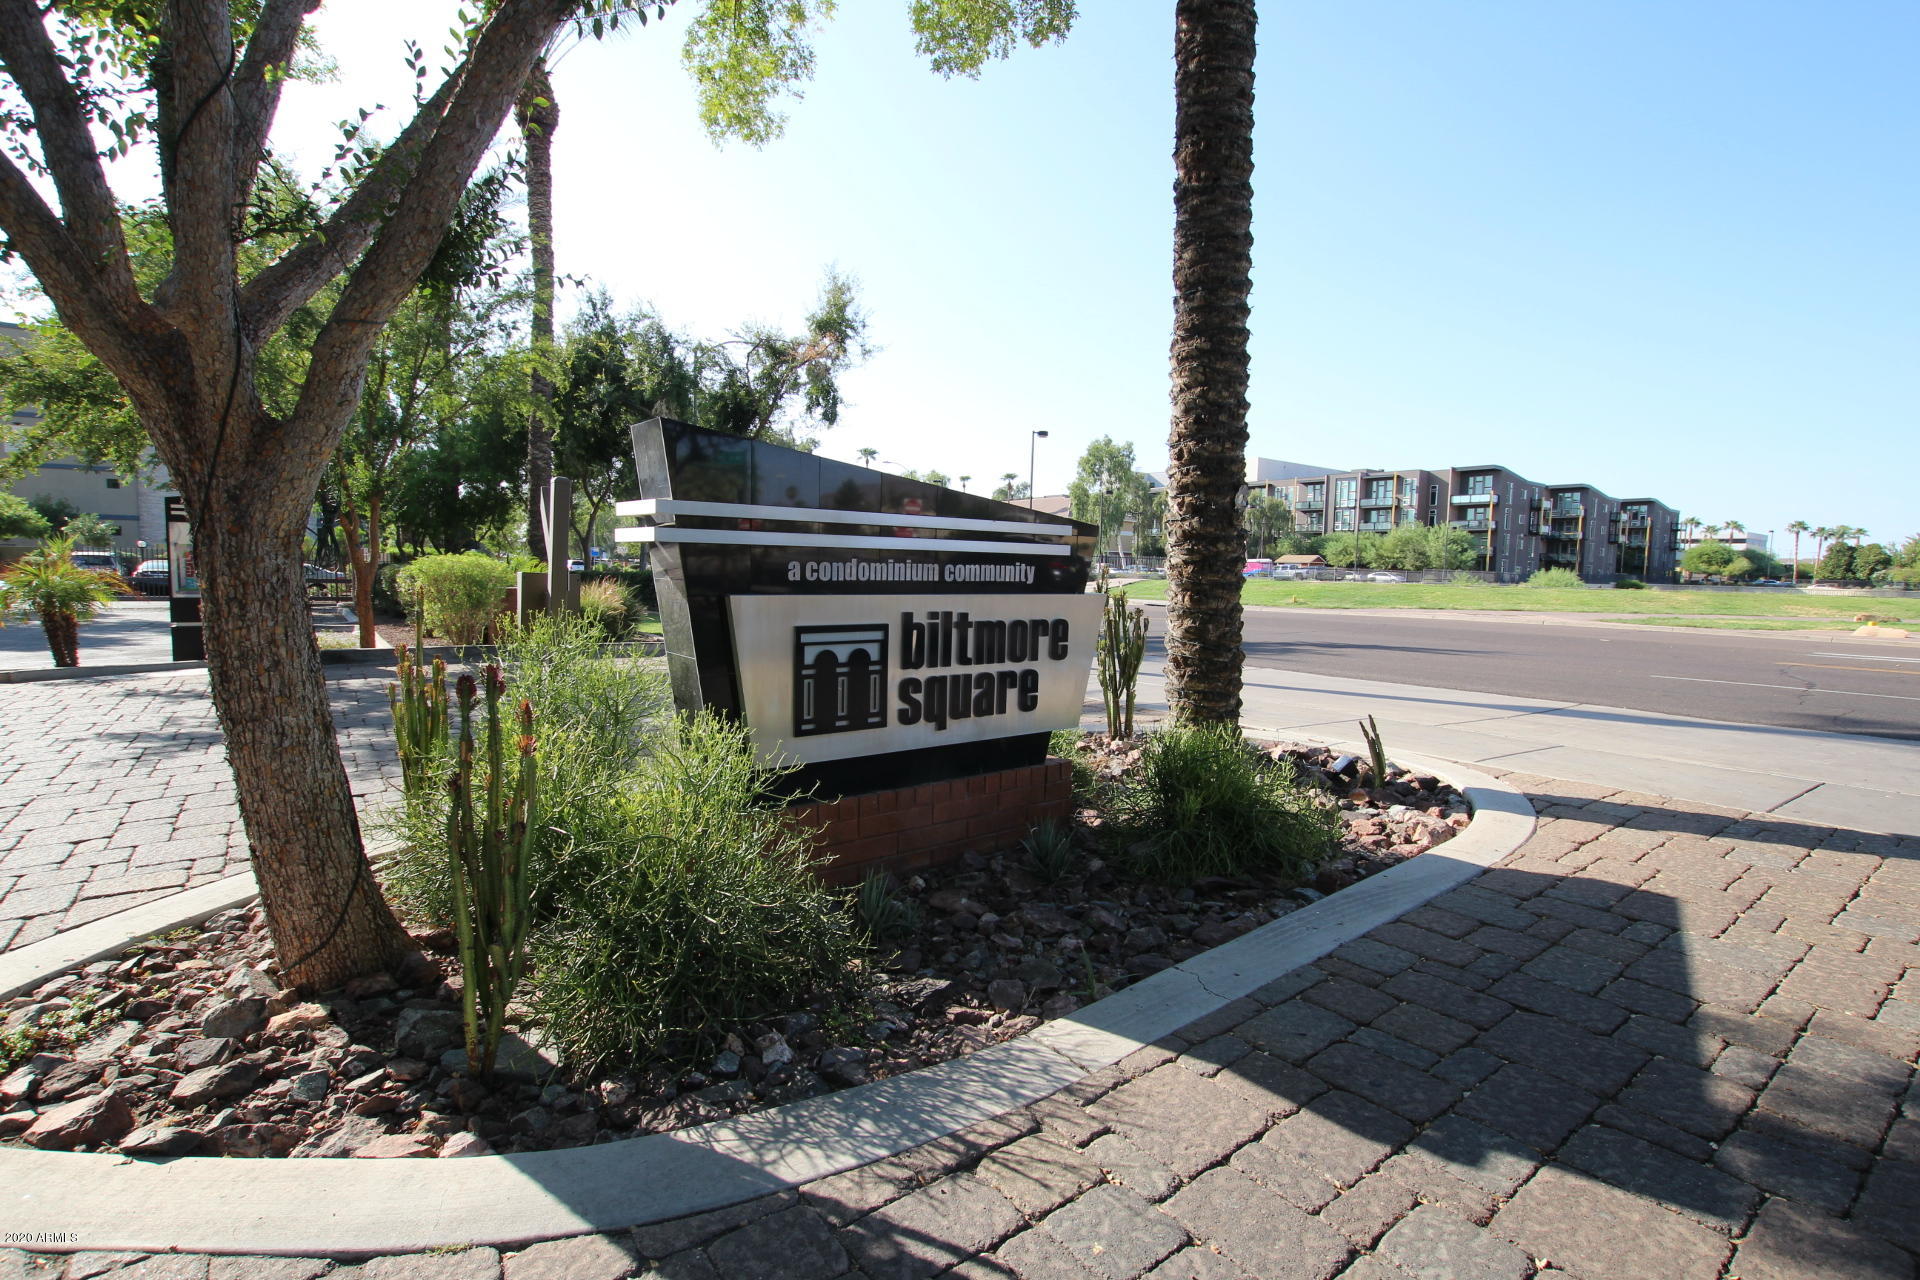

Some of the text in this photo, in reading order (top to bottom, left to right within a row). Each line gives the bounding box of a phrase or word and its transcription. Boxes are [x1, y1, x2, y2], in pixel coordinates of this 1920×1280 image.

[787, 558, 1036, 585] a condominium community
[901, 611, 1069, 670] biltmore
[897, 668, 1039, 732] square
